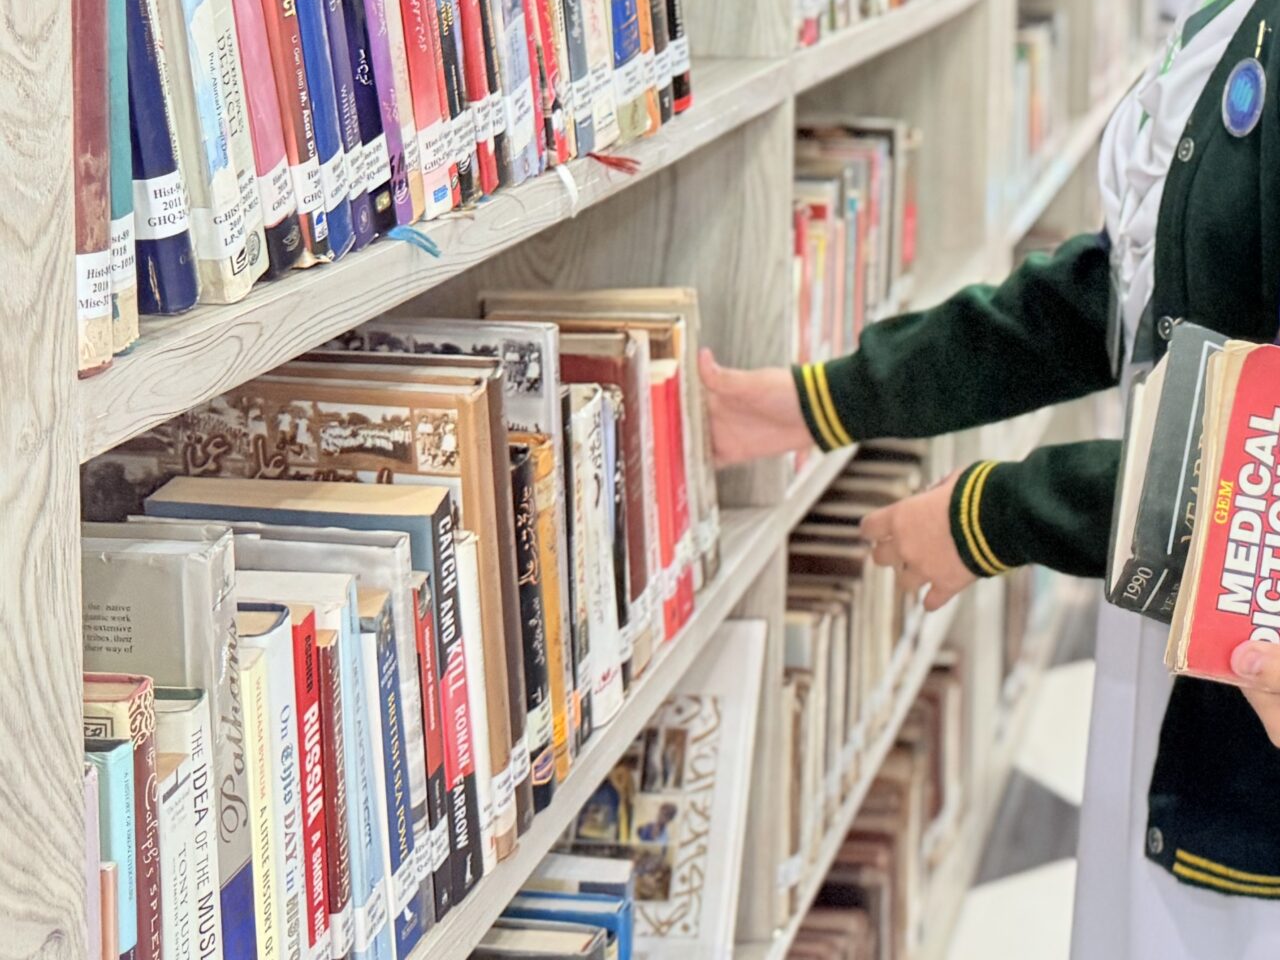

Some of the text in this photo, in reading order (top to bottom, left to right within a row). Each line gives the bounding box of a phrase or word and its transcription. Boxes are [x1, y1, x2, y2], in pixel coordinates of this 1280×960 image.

[299, 91, 309, 108] M.
[303, 109, 314, 140] Asad
[1214, 480, 1235, 525] GEM
[1122, 566, 1154, 601] 1990
[437, 515, 472, 849] CATCH AND KILL RONAN FARROW
[279, 704, 293, 739] On
[387, 692, 402, 768] BRITISH
[191, 726, 203, 761] THE
[192, 763, 209, 827] IDEA
[393, 772, 405, 805] SEA
[283, 808, 298, 864] DAY
[302, 700, 328, 938] RUSSIA A SHORT HIS
[195, 830, 208, 851] OF
[260, 815, 272, 864] LITTLE
[177, 842, 190, 905] TONY
[196, 854, 209, 890] THE
[285, 869, 298, 892] in
[262, 869, 275, 932] HISTORY
[265, 934, 277, 957] OF
